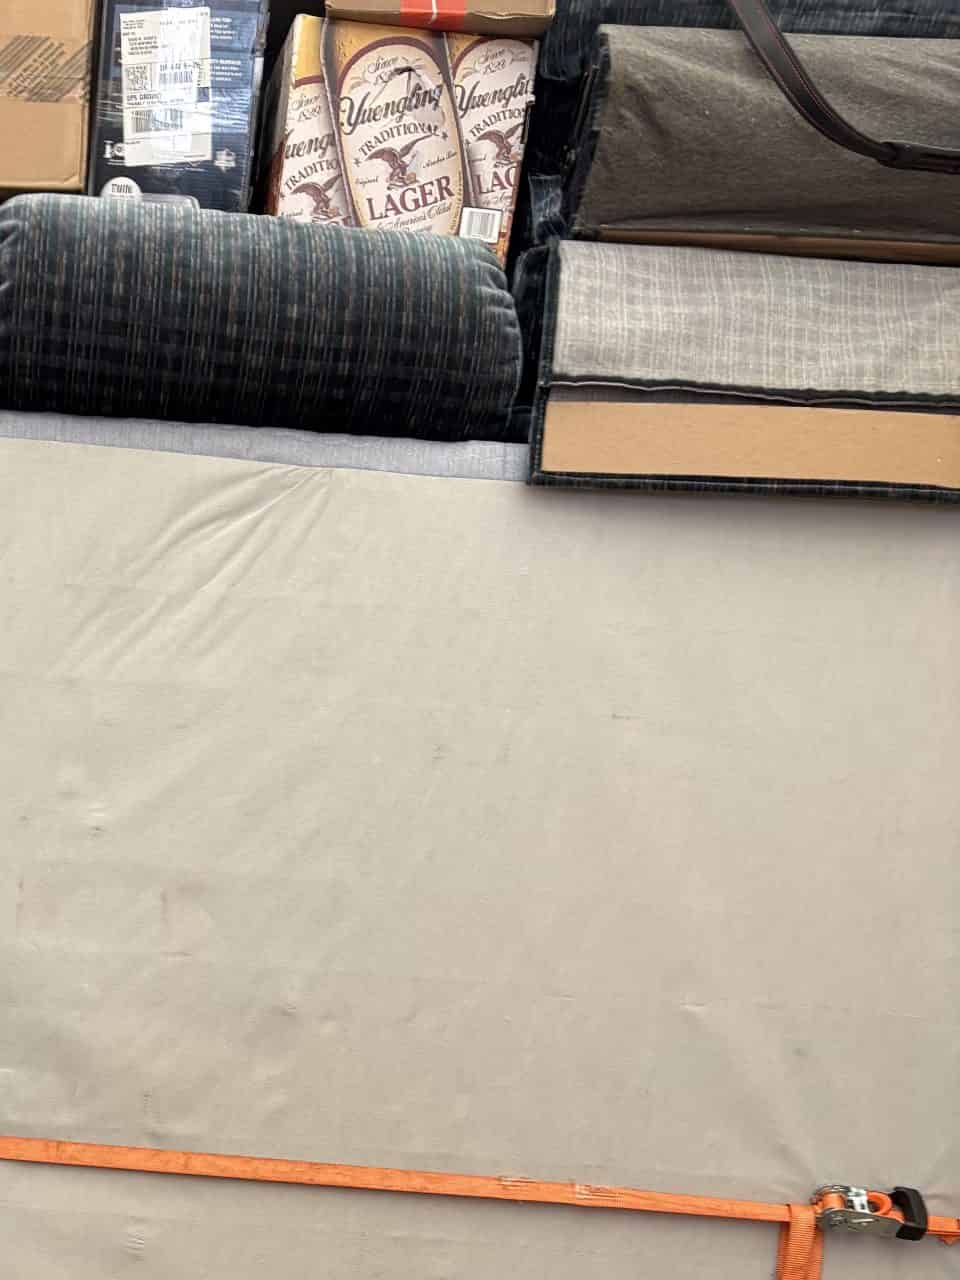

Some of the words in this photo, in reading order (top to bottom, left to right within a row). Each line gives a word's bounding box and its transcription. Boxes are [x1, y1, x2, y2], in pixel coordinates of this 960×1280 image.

[337, 82, 443, 136] Yuengling
[358, 121, 441, 158] TRADITIONAL
[366, 175, 455, 221] LAGER
